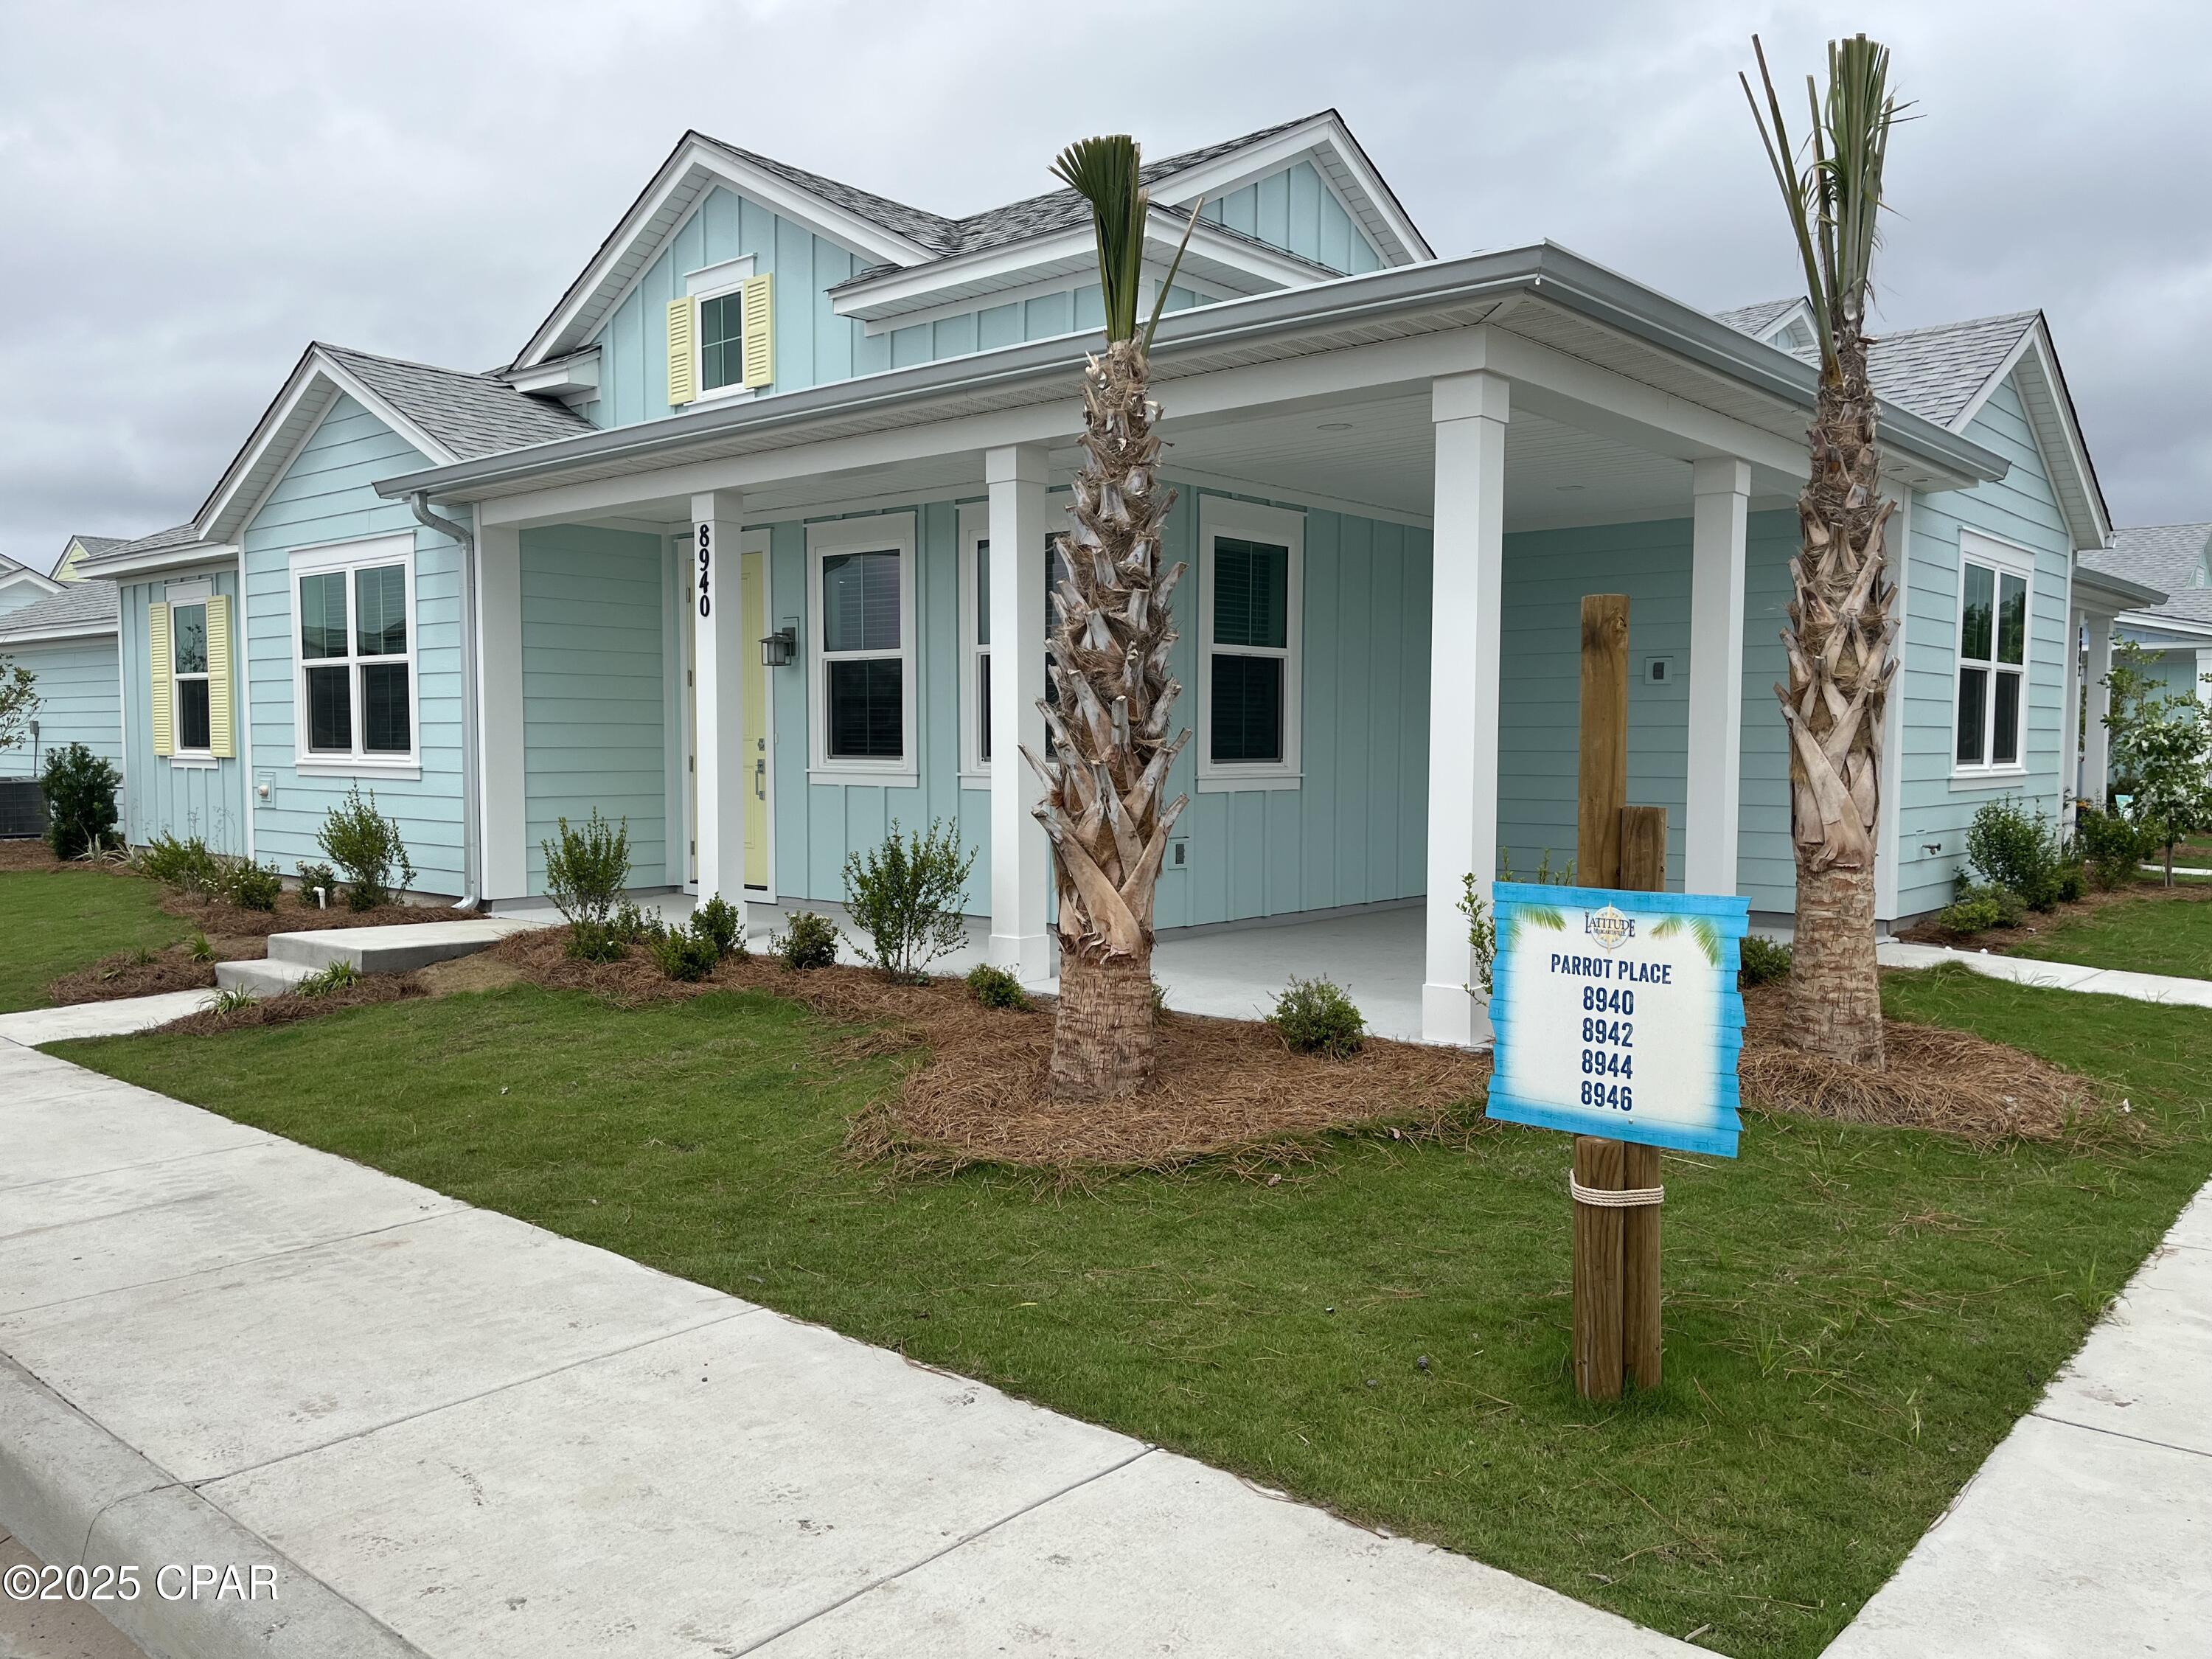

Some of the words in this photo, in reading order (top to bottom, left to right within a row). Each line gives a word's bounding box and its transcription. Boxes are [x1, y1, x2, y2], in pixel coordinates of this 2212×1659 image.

[699, 524, 710, 617] 8940
[1551, 953, 1613, 979] PARROT
[1618, 961, 1672, 984] PLACE
[1582, 986, 1634, 1015] 8940
[1582, 1018, 1633, 1048] 8942
[1582, 1049, 1633, 1079] 8944
[1581, 1081, 1632, 1111] 8946
